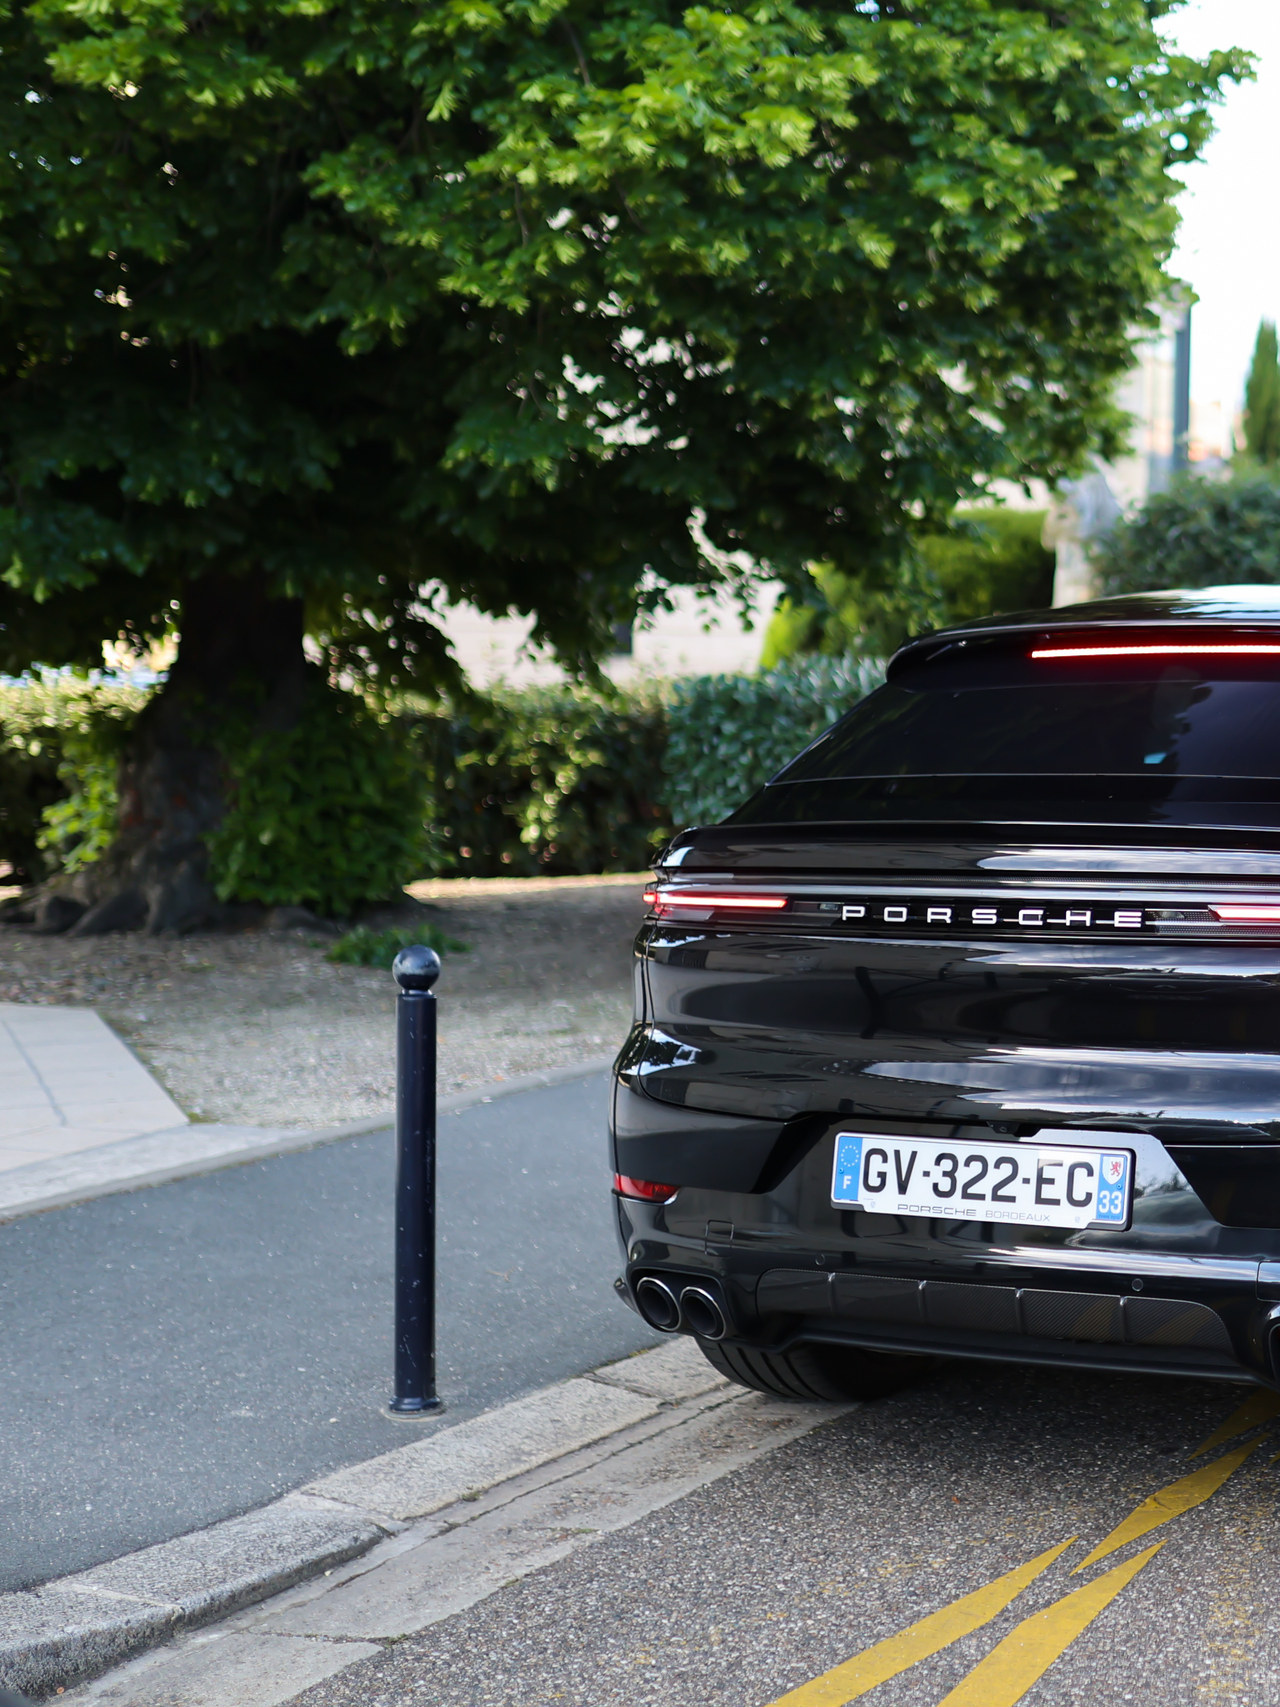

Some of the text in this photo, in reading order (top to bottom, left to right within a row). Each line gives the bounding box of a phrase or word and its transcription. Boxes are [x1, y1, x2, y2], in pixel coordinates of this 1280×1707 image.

[841, 905, 1143, 928] PORSCHE
[843, 1175, 852, 1190] F
[862, 1147, 1094, 1208] GV-322-EC
[897, 1203, 1050, 1222] PORSCHE BORDEAUX
[1098, 1190, 1122, 1214] 33
